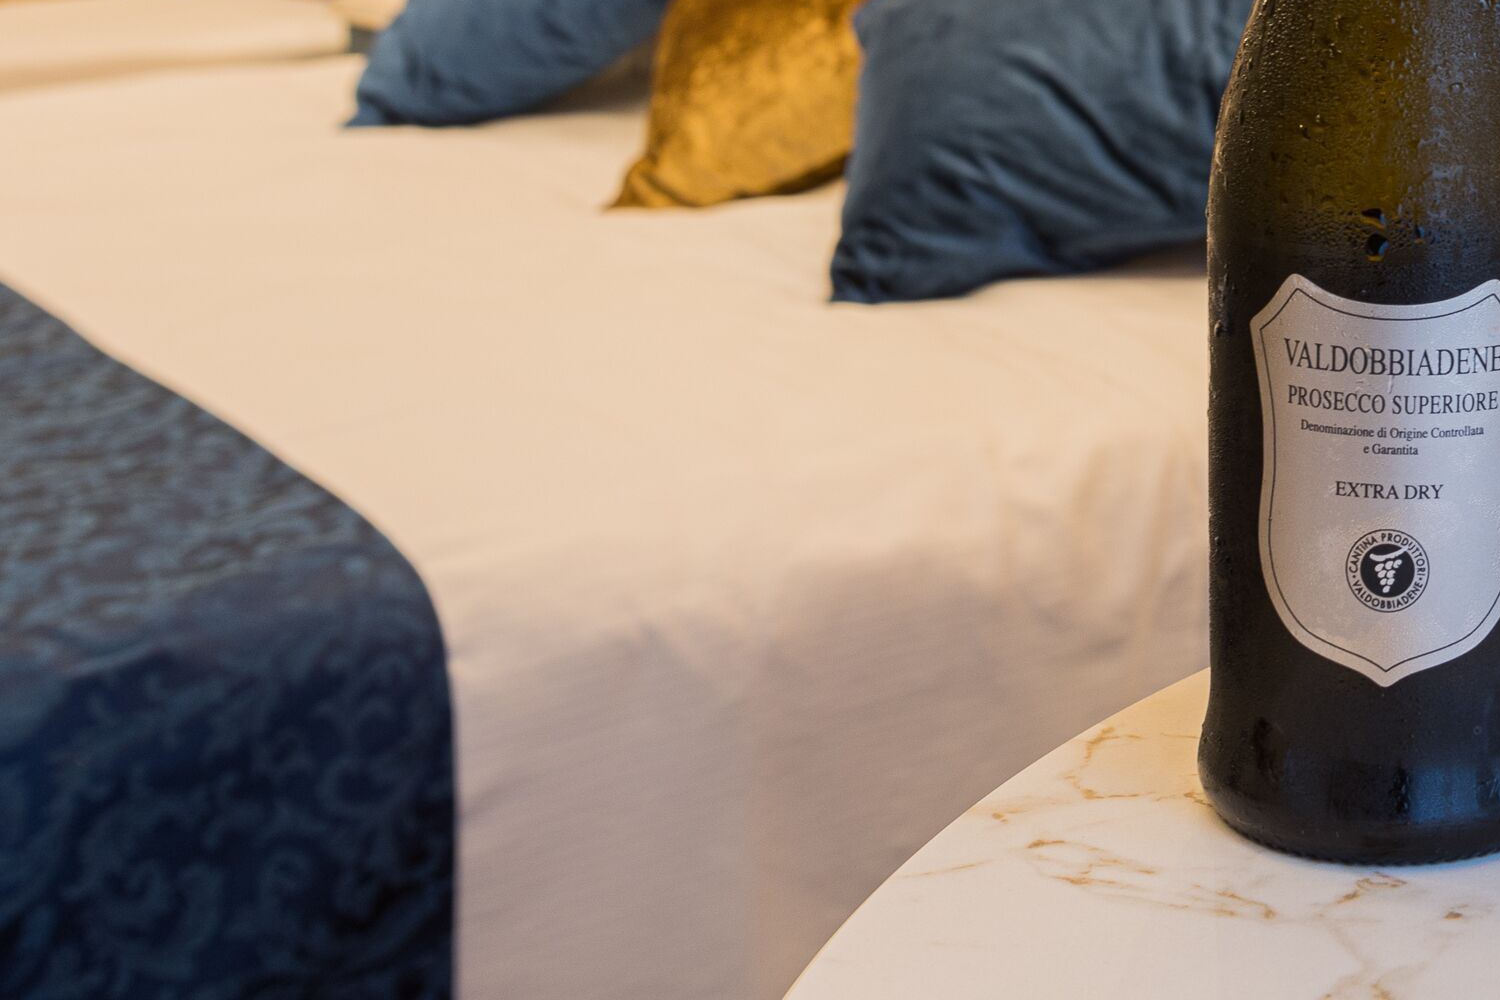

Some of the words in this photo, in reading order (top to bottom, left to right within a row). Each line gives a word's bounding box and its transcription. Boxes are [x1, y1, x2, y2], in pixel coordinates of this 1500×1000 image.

[1287, 384, 1386, 414] PROSECCO
[1392, 390, 1499, 415] SUPERIORE
[1300, 419, 1375, 438] Denominazione
[1377, 427, 1387, 438] di
[1389, 428, 1428, 441] Origine
[1430, 425, 1484, 438] Controllata
[1363, 446, 1370, 455] e
[1371, 444, 1419, 456] Garantita
[1335, 481, 1399, 500] EXTRA
[1404, 484, 1444, 500] DRY
[1348, 535, 1378, 573] CANTINA
[1381, 533, 1426, 576] PRODUTTORI
[1352, 580, 1423, 609] VALDOBBIADENE
